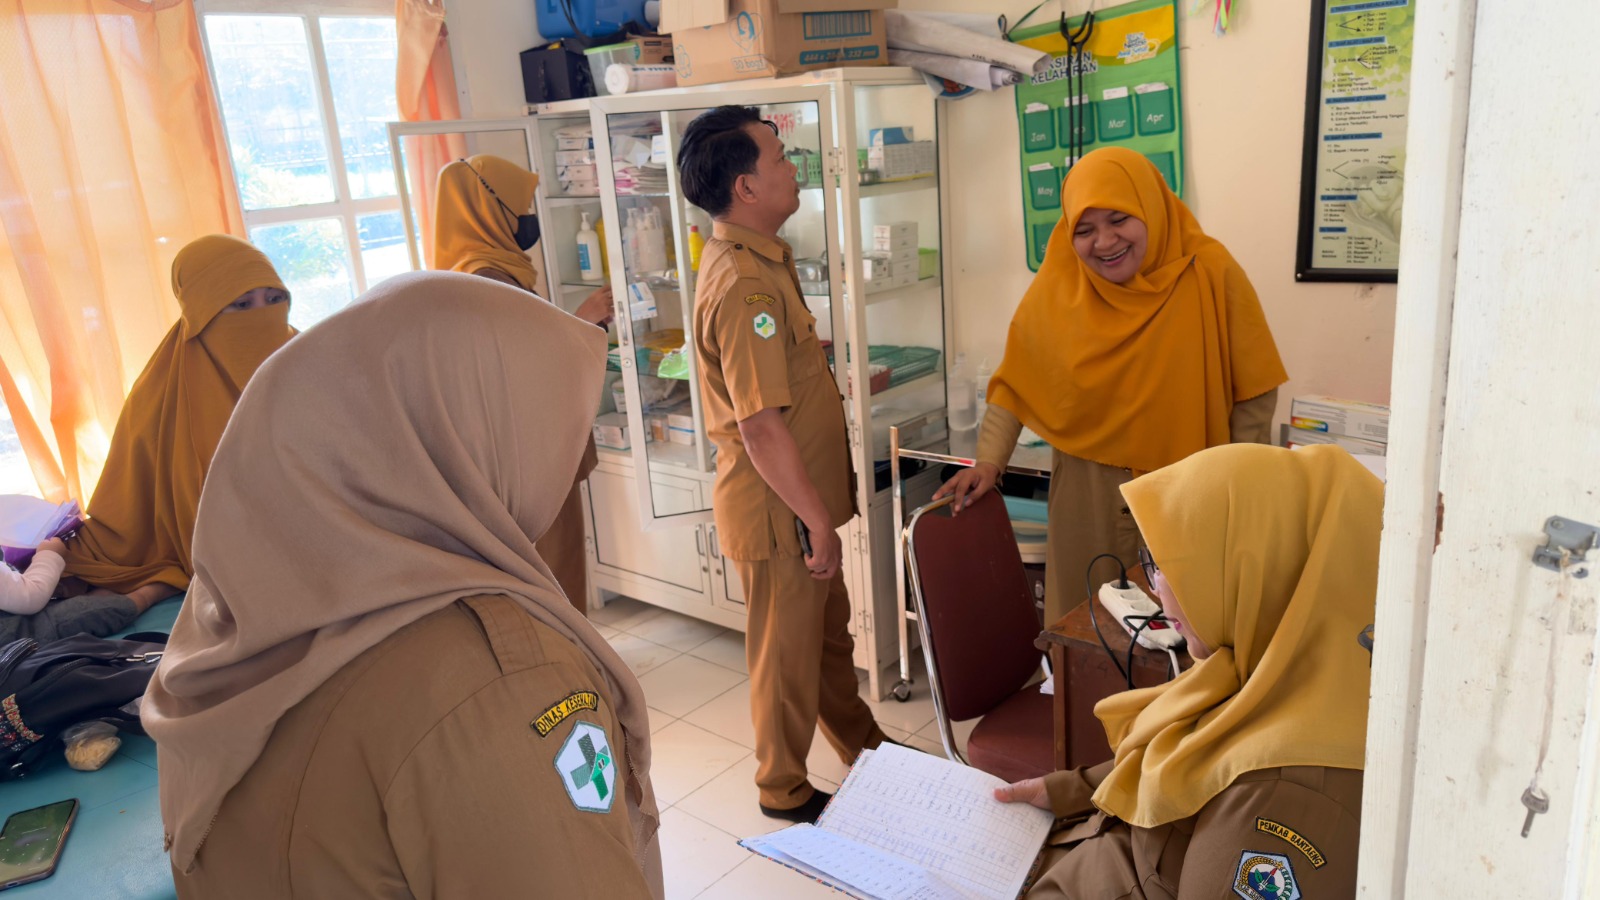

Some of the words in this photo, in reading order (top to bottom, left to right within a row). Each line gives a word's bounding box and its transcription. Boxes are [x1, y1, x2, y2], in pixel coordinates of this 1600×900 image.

[1030, 61, 1097, 84] KELAHRAN
[1108, 119, 1127, 129] Mar
[1146, 113, 1164, 125] Apr
[1031, 132, 1046, 142] Jan
[1037, 186, 1053, 197] May
[536, 706, 563, 733] DINAS
[1259, 820, 1289, 838] PEMKAB
[1290, 834, 1322, 866] BANTAENG
